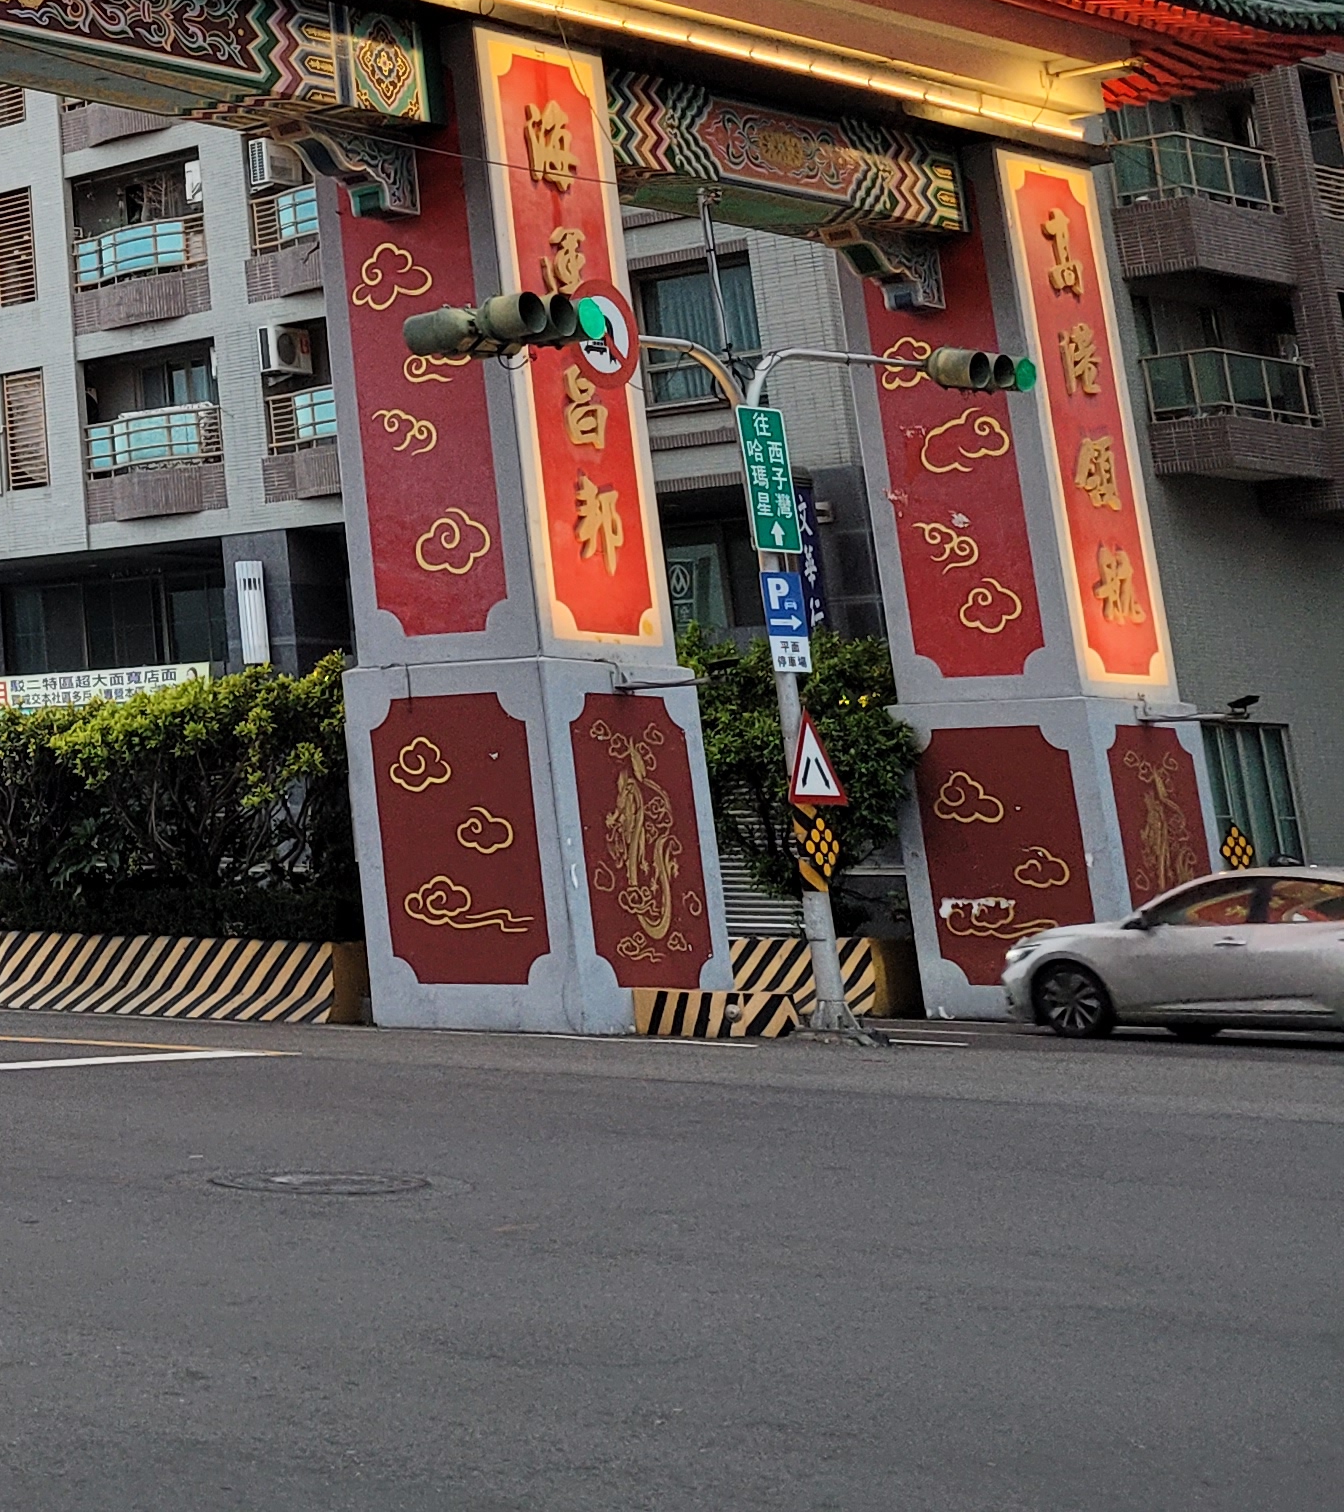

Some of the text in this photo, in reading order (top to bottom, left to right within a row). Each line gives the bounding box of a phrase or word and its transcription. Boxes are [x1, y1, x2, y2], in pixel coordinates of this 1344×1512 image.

[752, 411, 772, 438] 往
[1041, 208, 1146, 626] 高港領航
[746, 439, 775, 518] 哈瑪星
[767, 440, 793, 520] 西子灣
[766, 577, 790, 610] P
